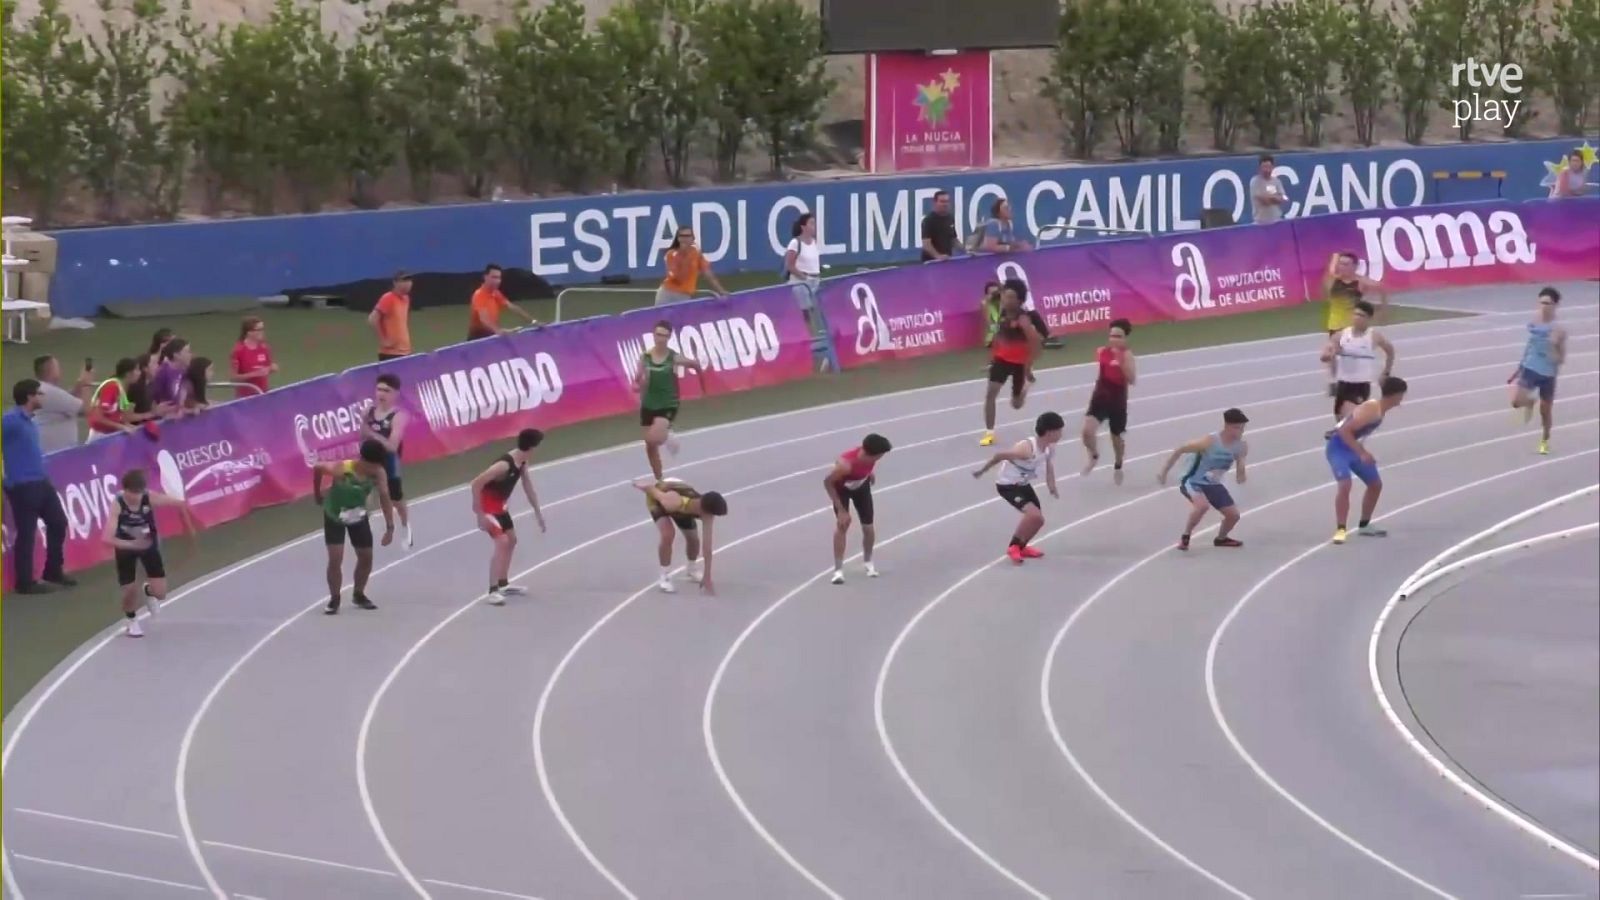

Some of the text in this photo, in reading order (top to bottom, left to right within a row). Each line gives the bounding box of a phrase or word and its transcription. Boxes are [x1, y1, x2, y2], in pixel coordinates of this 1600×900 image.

[905, 133, 918, 144] LA
[530, 199, 748, 275] ESTADI
[1025, 169, 1246, 240] CAMILO
[1270, 158, 1425, 222] CANO
[1217, 265, 1281, 288] DIPUTACIÓN
[1218, 286, 1285, 307] DE ALICANTE
[1061, 306, 1111, 326] ALICANTE
[440, 352, 564, 427] MONDO
[175, 439, 233, 470] RIESGO
